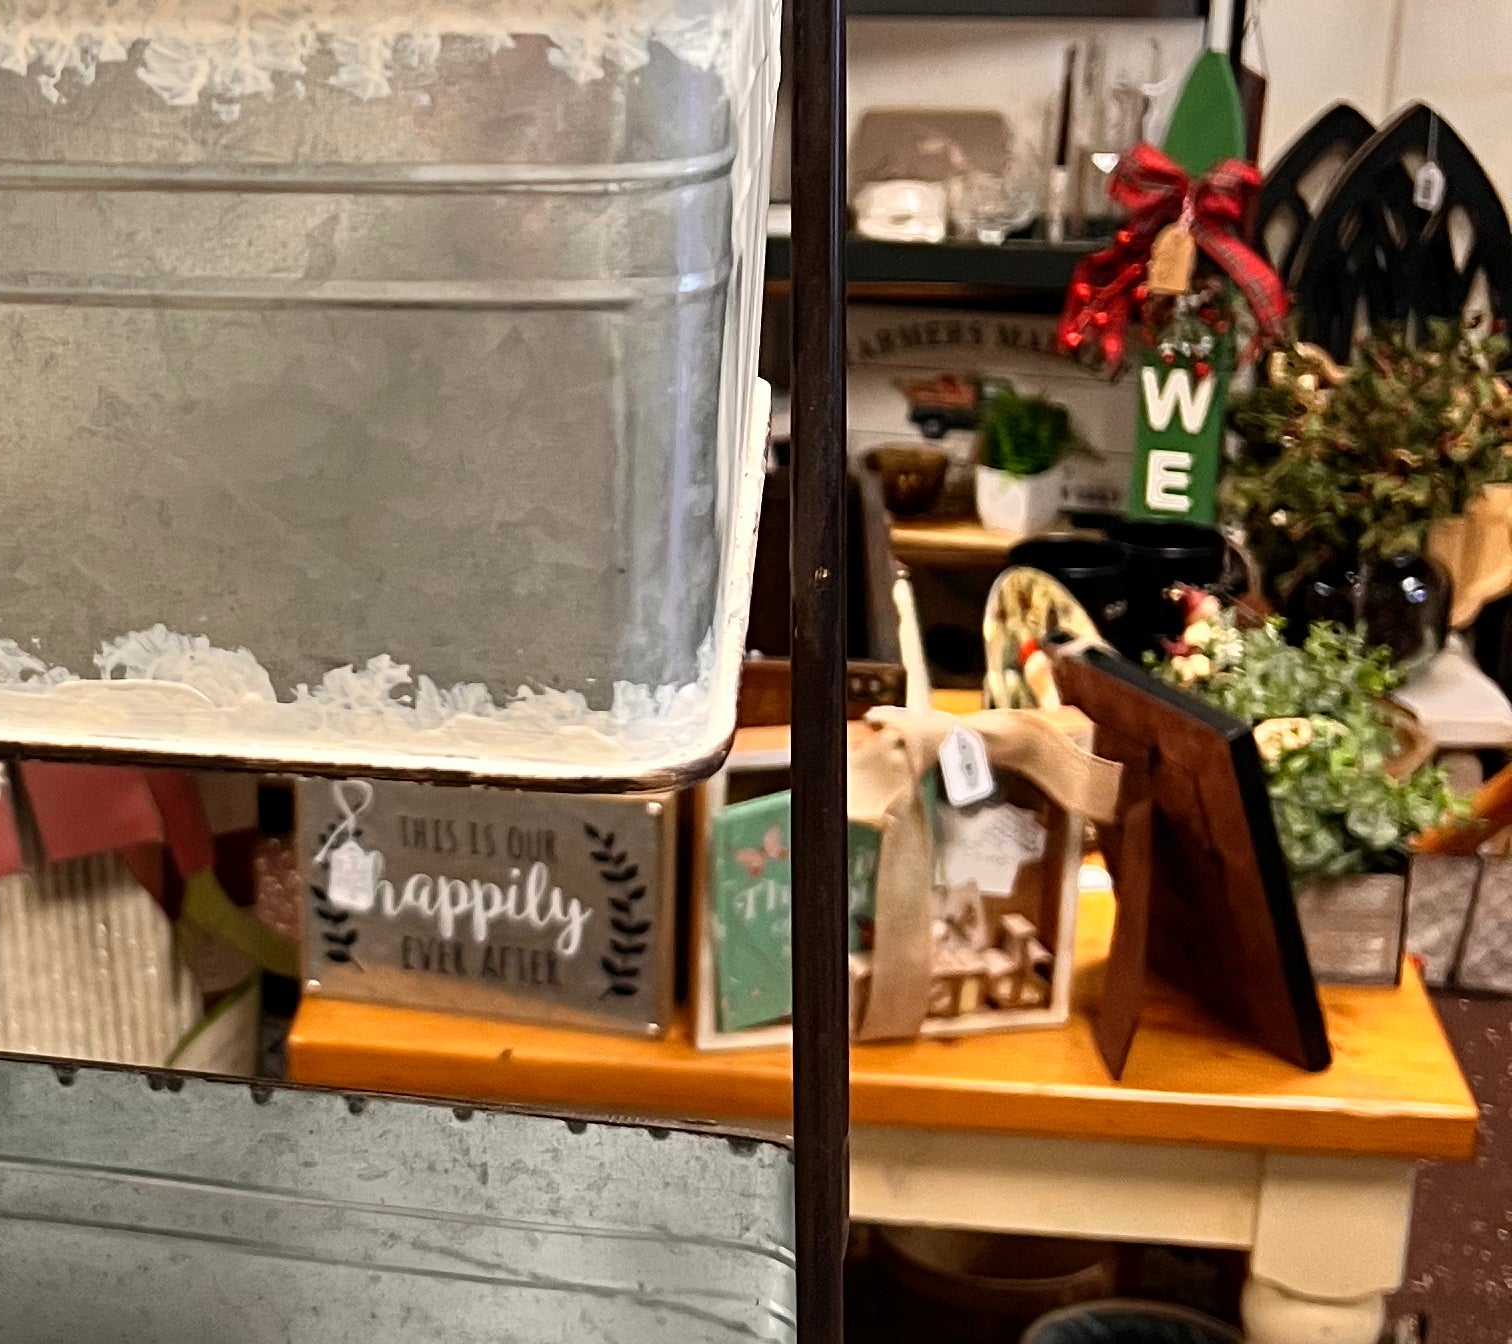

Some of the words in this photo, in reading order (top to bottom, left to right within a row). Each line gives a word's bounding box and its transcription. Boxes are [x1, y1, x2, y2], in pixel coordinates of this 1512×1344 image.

[399, 815, 457, 854] THIS
[468, 821, 496, 857] IS
[507, 825, 557, 862] OUR
[372, 850, 595, 956] happily
[401, 935, 468, 976] EVER
[483, 943, 560, 985] AFTER
